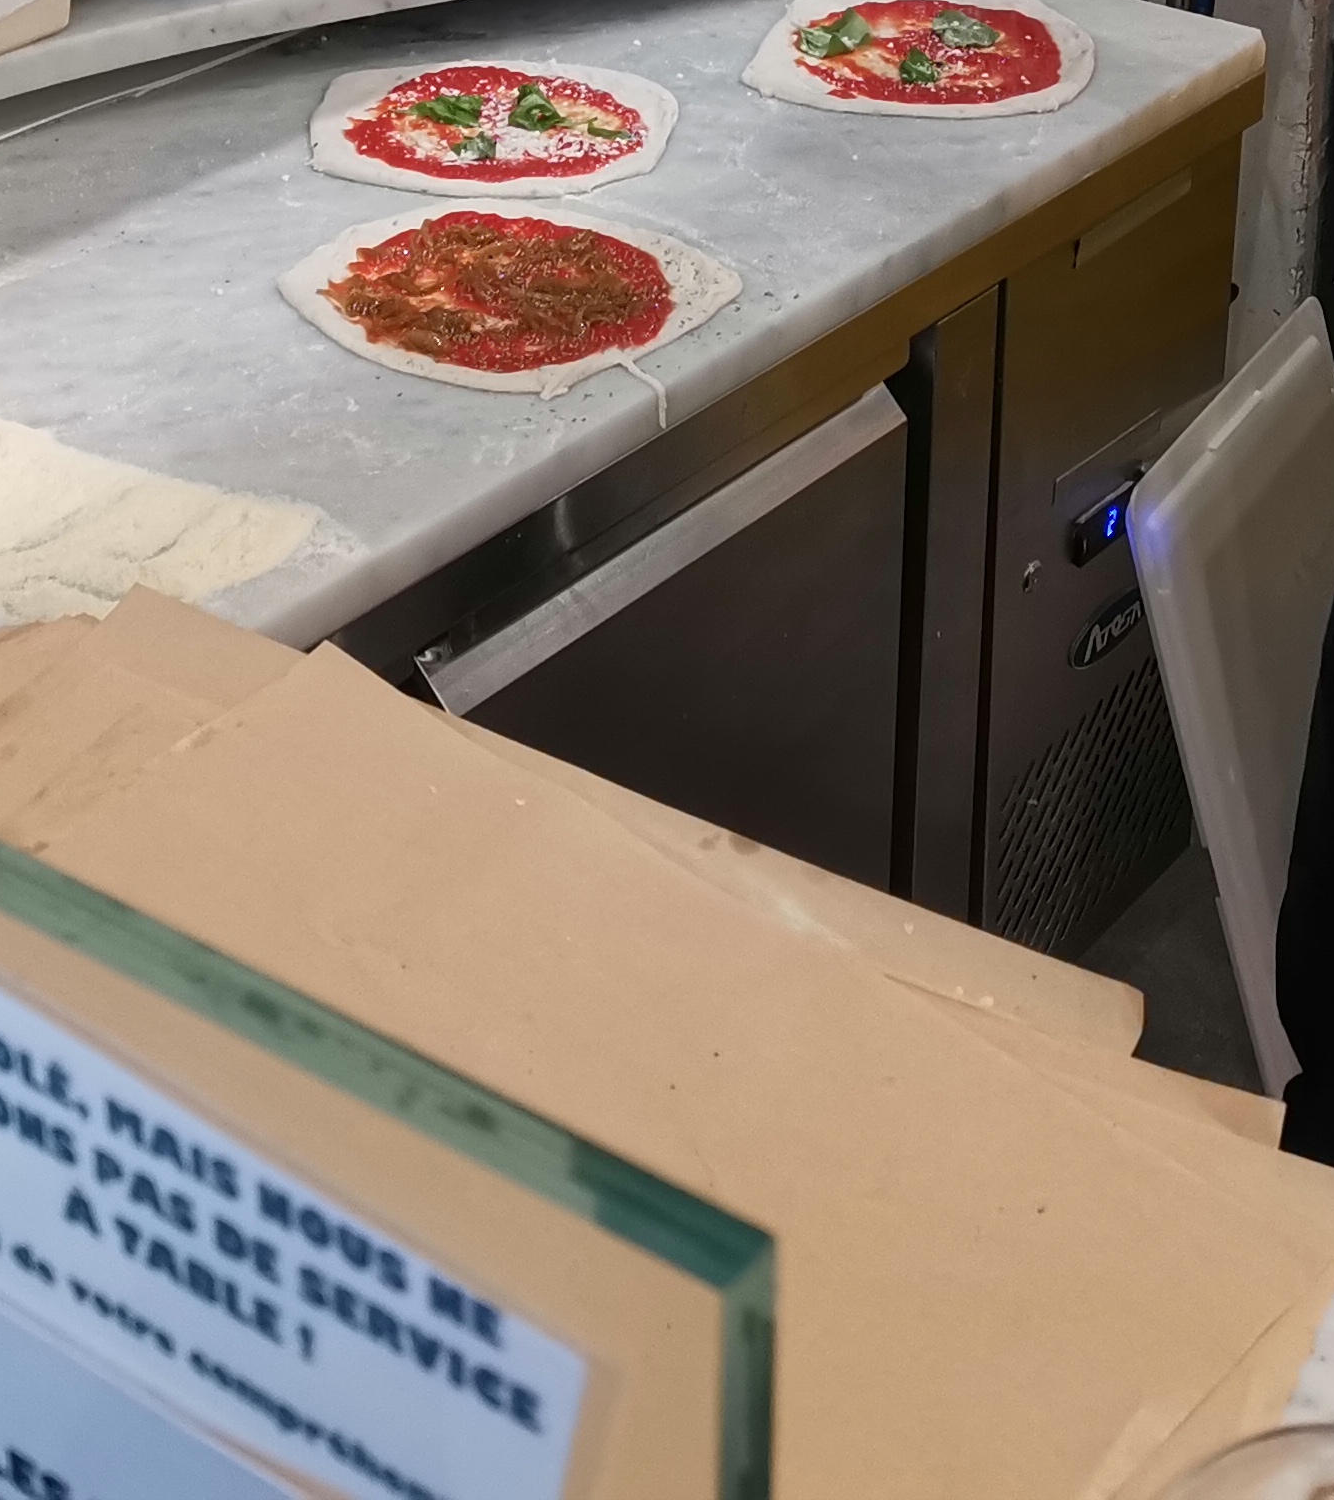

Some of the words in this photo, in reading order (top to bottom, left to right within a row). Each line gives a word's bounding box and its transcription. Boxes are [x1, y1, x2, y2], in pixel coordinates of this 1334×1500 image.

[10, 1243, 56, 1286] de
[68, 1276, 176, 1359] votre
[92, 1147, 197, 1235] PAS
[213, 1216, 281, 1287] DE
[298, 1265, 545, 1437] SERVICE
[104, 1096, 239, 1199] MAIS
[257, 1182, 408, 1293] NOUS
[428, 1275, 505, 1350] NE
[115, 1217, 284, 1346] TABLE
